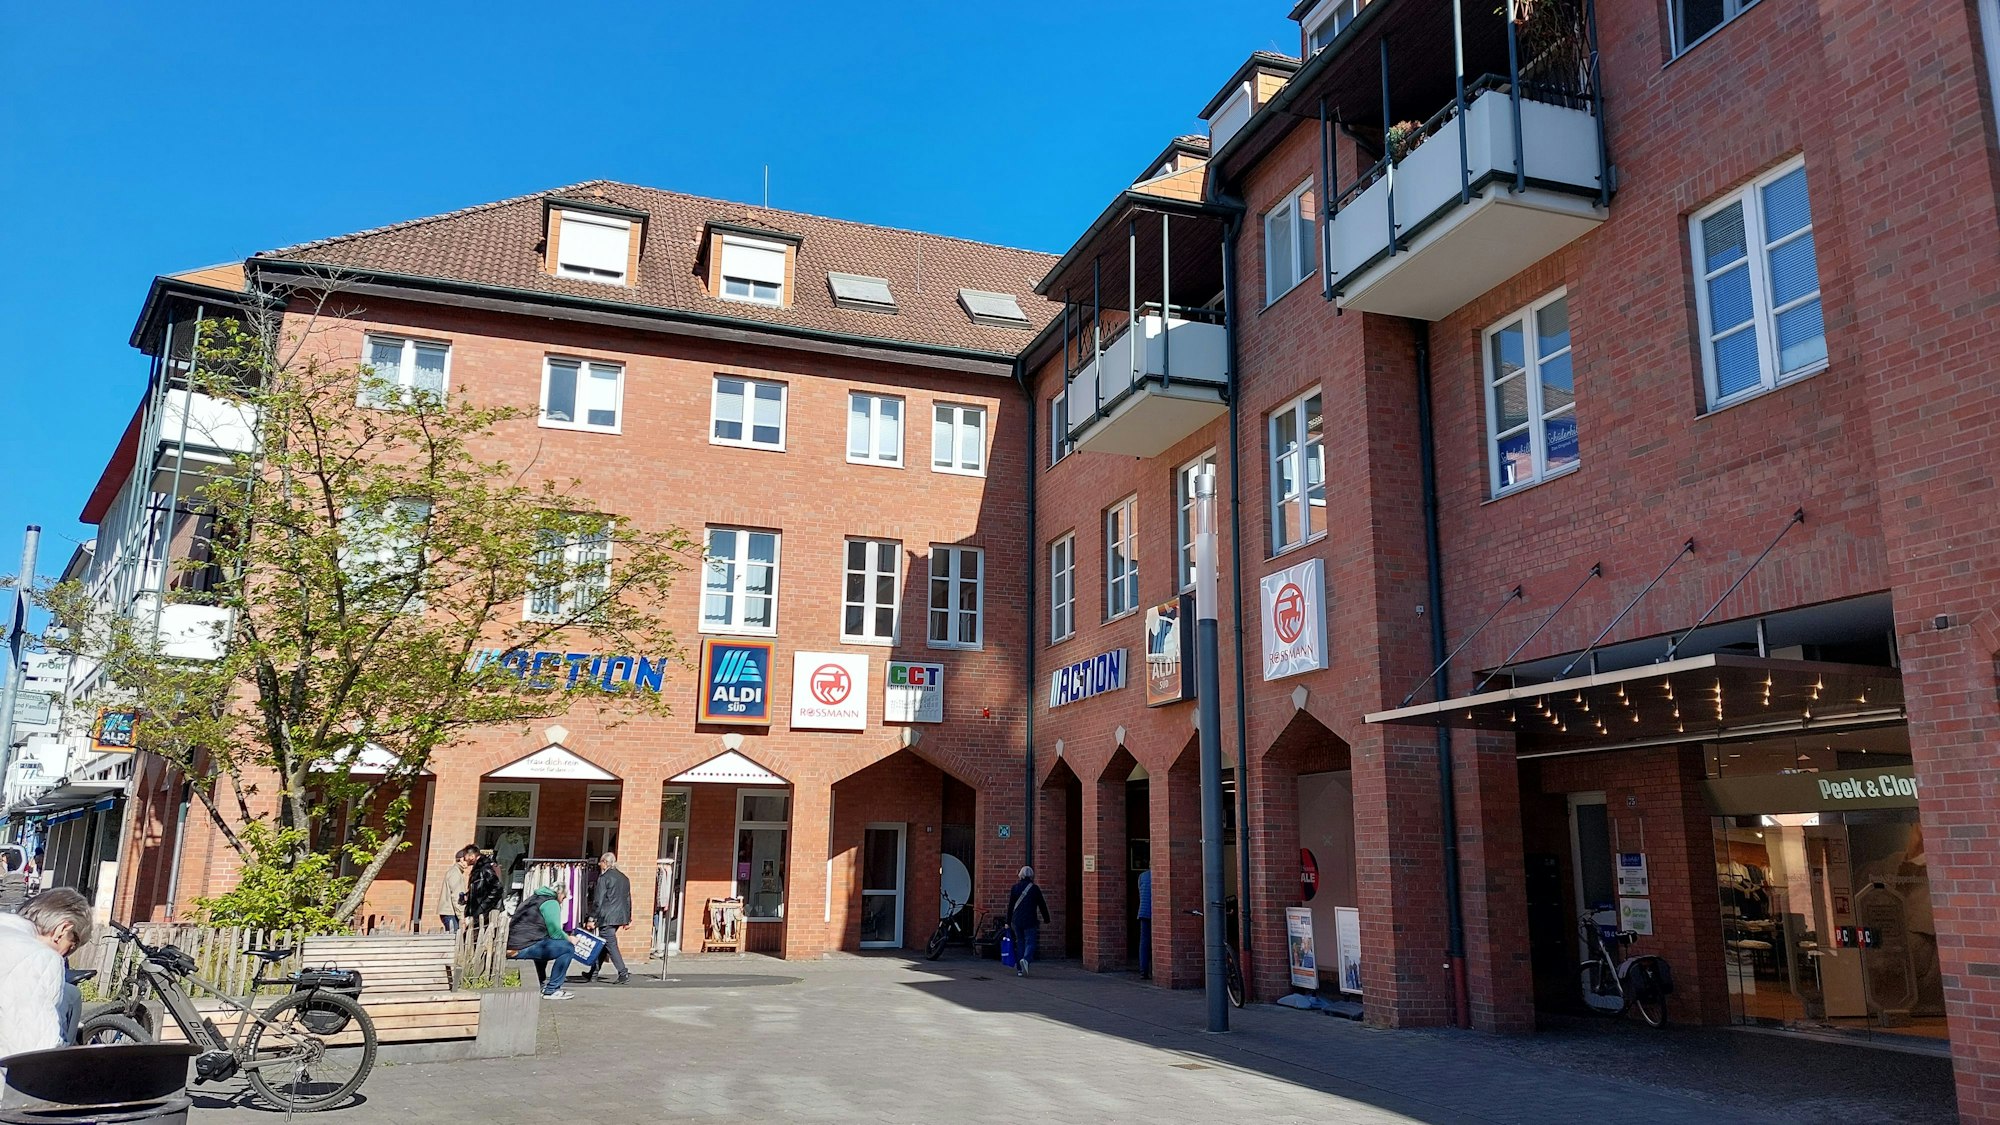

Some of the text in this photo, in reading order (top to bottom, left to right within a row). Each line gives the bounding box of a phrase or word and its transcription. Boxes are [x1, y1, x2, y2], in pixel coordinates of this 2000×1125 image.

[1269, 644, 1314, 665] ROSSMANN
[36, 661, 67, 670] SPORT
[498, 649, 668, 693] ACTION
[890, 665, 940, 686] CCT
[1151, 656, 1176, 681] ALDI
[1058, 649, 1121, 705] ACTION
[1159, 678, 1169, 690] SÜD
[712, 686, 762, 703] ALDI
[727, 701, 746, 712] SÜD
[800, 707, 860, 718] ROSSMANN
[1818, 777, 1866, 799] Peek
[1866, 780, 1881, 797] &
[1300, 872, 1316, 883] ALE
[188, 1021, 212, 1046] DICE
